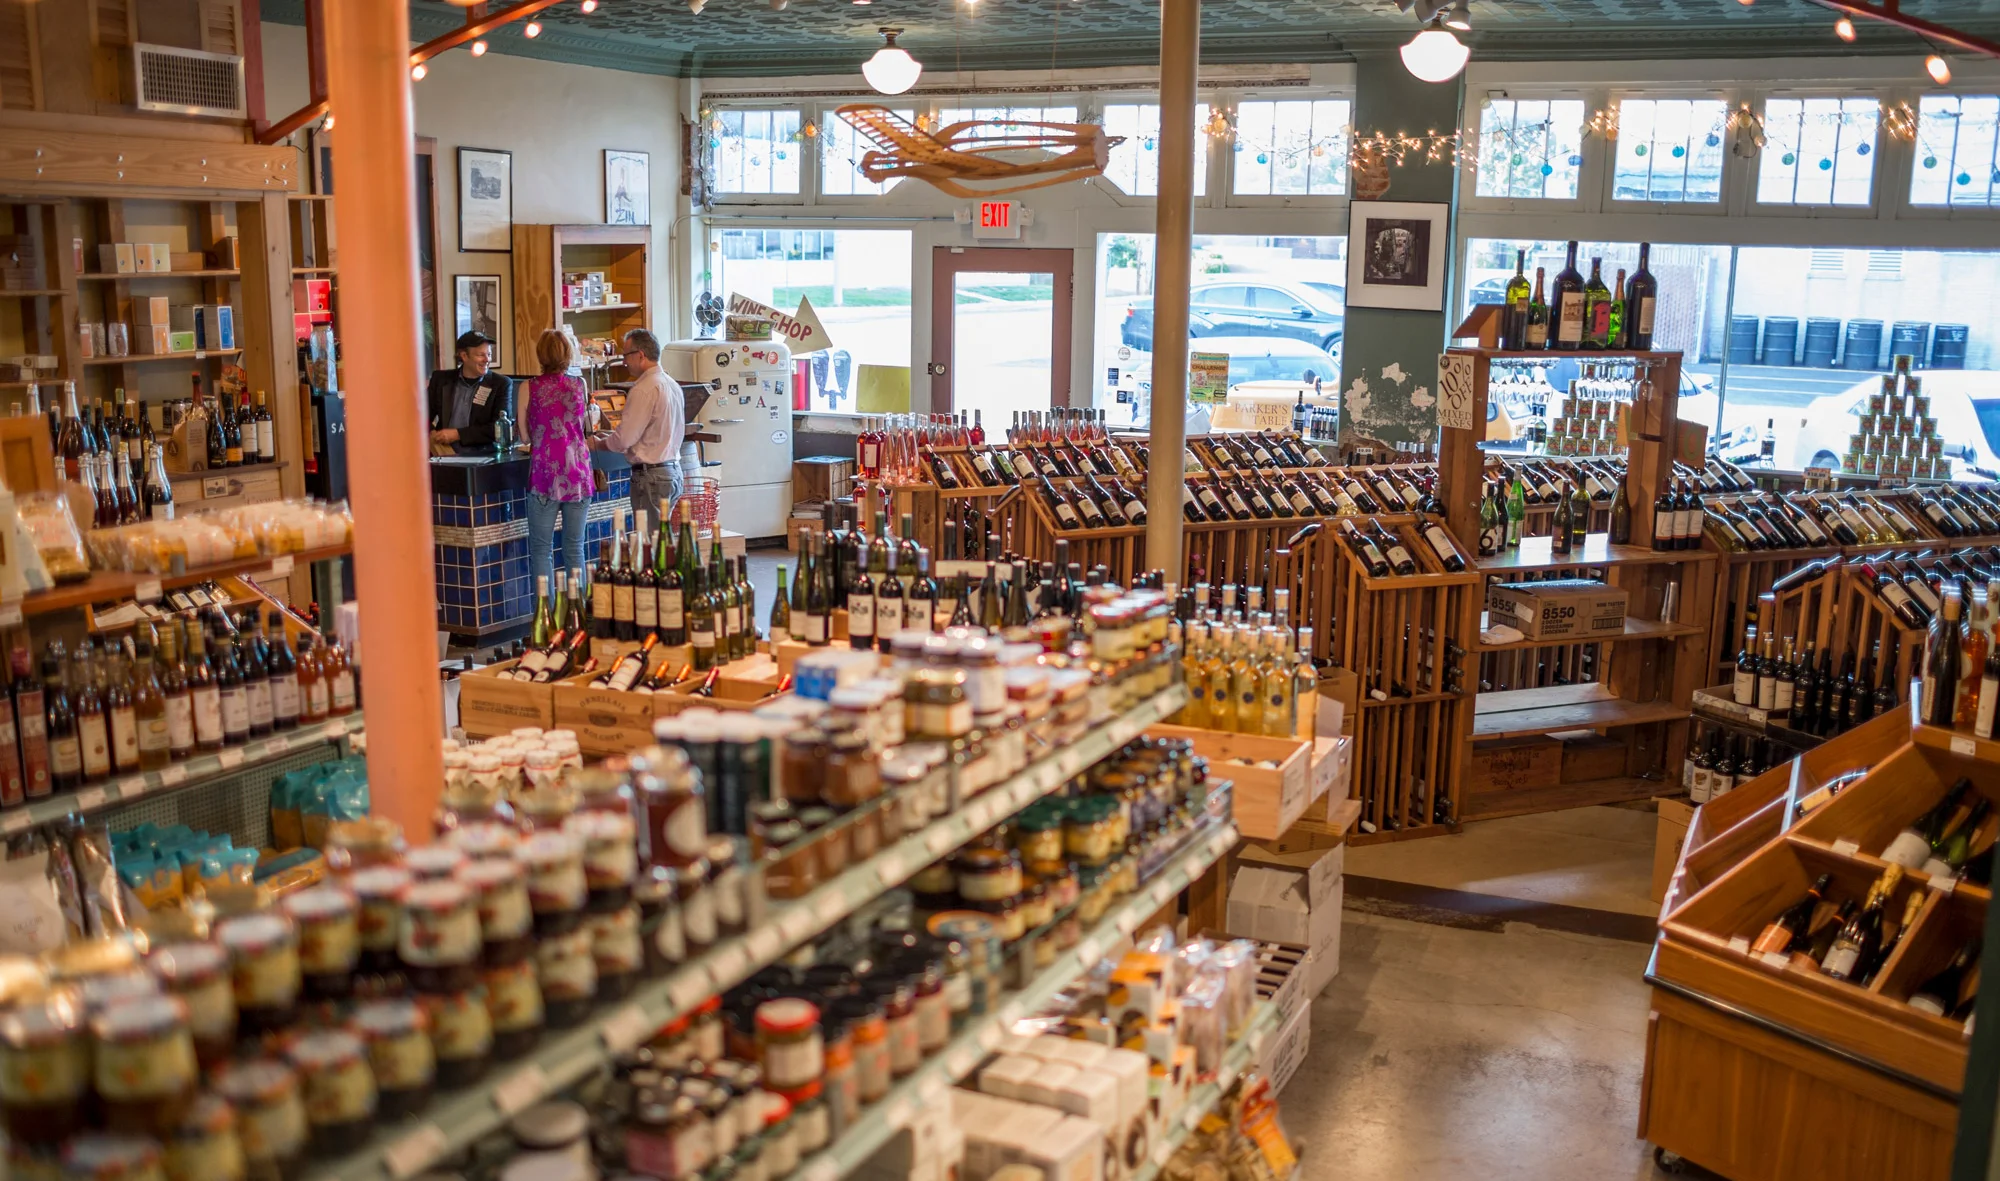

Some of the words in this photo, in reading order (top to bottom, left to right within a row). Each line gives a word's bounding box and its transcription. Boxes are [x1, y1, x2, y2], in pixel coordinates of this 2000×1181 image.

[615, 209, 636, 225] ZIN
[981, 202, 1011, 227] EXIT
[729, 294, 766, 315] WINE
[1439, 356, 1471, 400] 10%
[1451, 377, 1472, 410] OFF
[756, 395, 767, 408] A
[1234, 403, 1289, 415] PARKER'S
[1438, 408, 1472, 420] MIXED
[1252, 414, 1288, 426] TABLE
[1437, 416, 1472, 429] CASES
[1542, 606, 1575, 620] 8550
